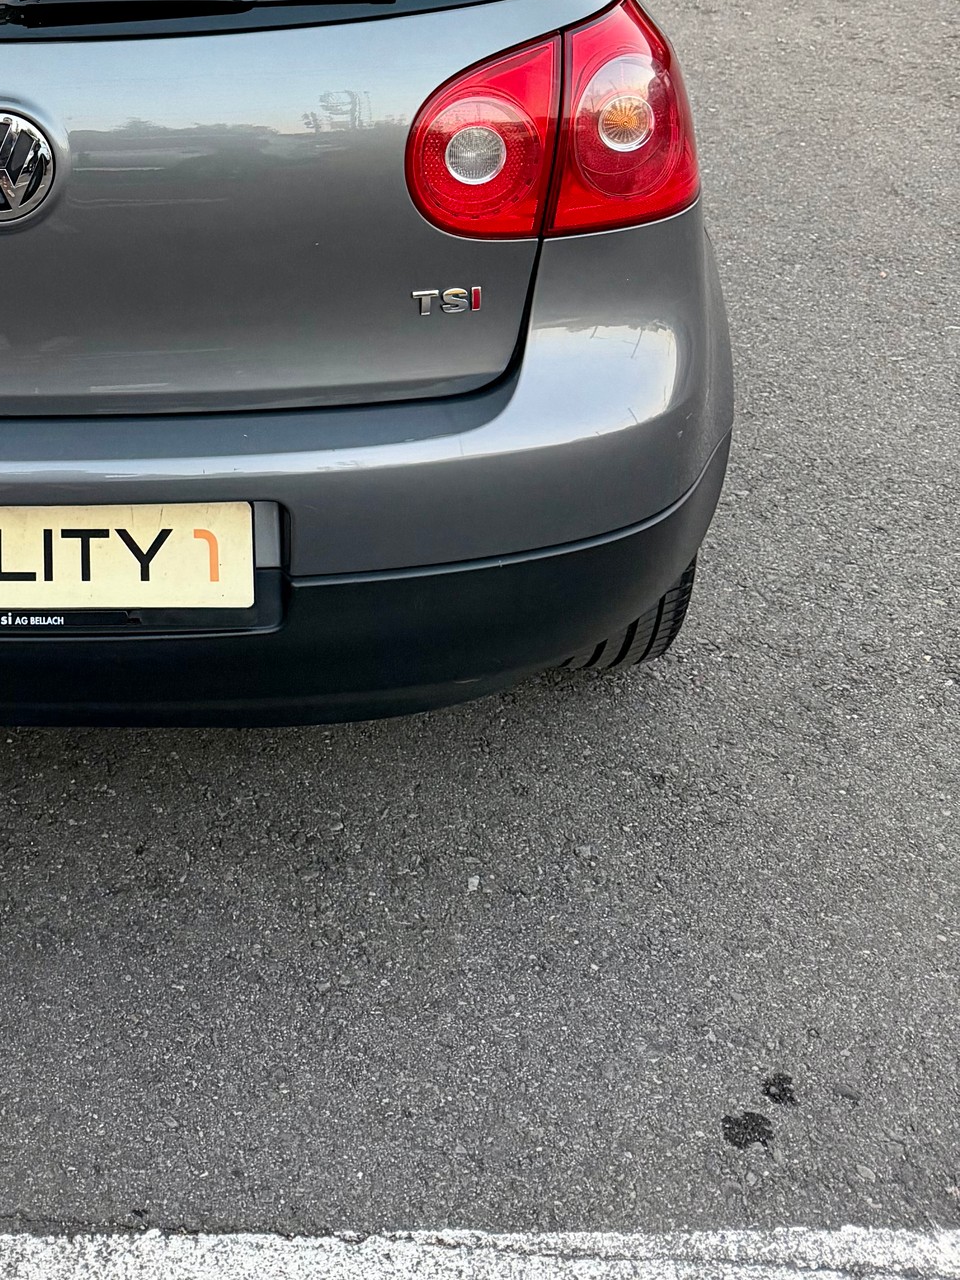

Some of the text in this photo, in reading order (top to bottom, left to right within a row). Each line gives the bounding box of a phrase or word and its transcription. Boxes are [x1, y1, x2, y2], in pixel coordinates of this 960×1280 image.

[412, 286, 482, 316] TSI
[14, 616, 29, 625] AG
[29, 616, 65, 625] BELLACH
